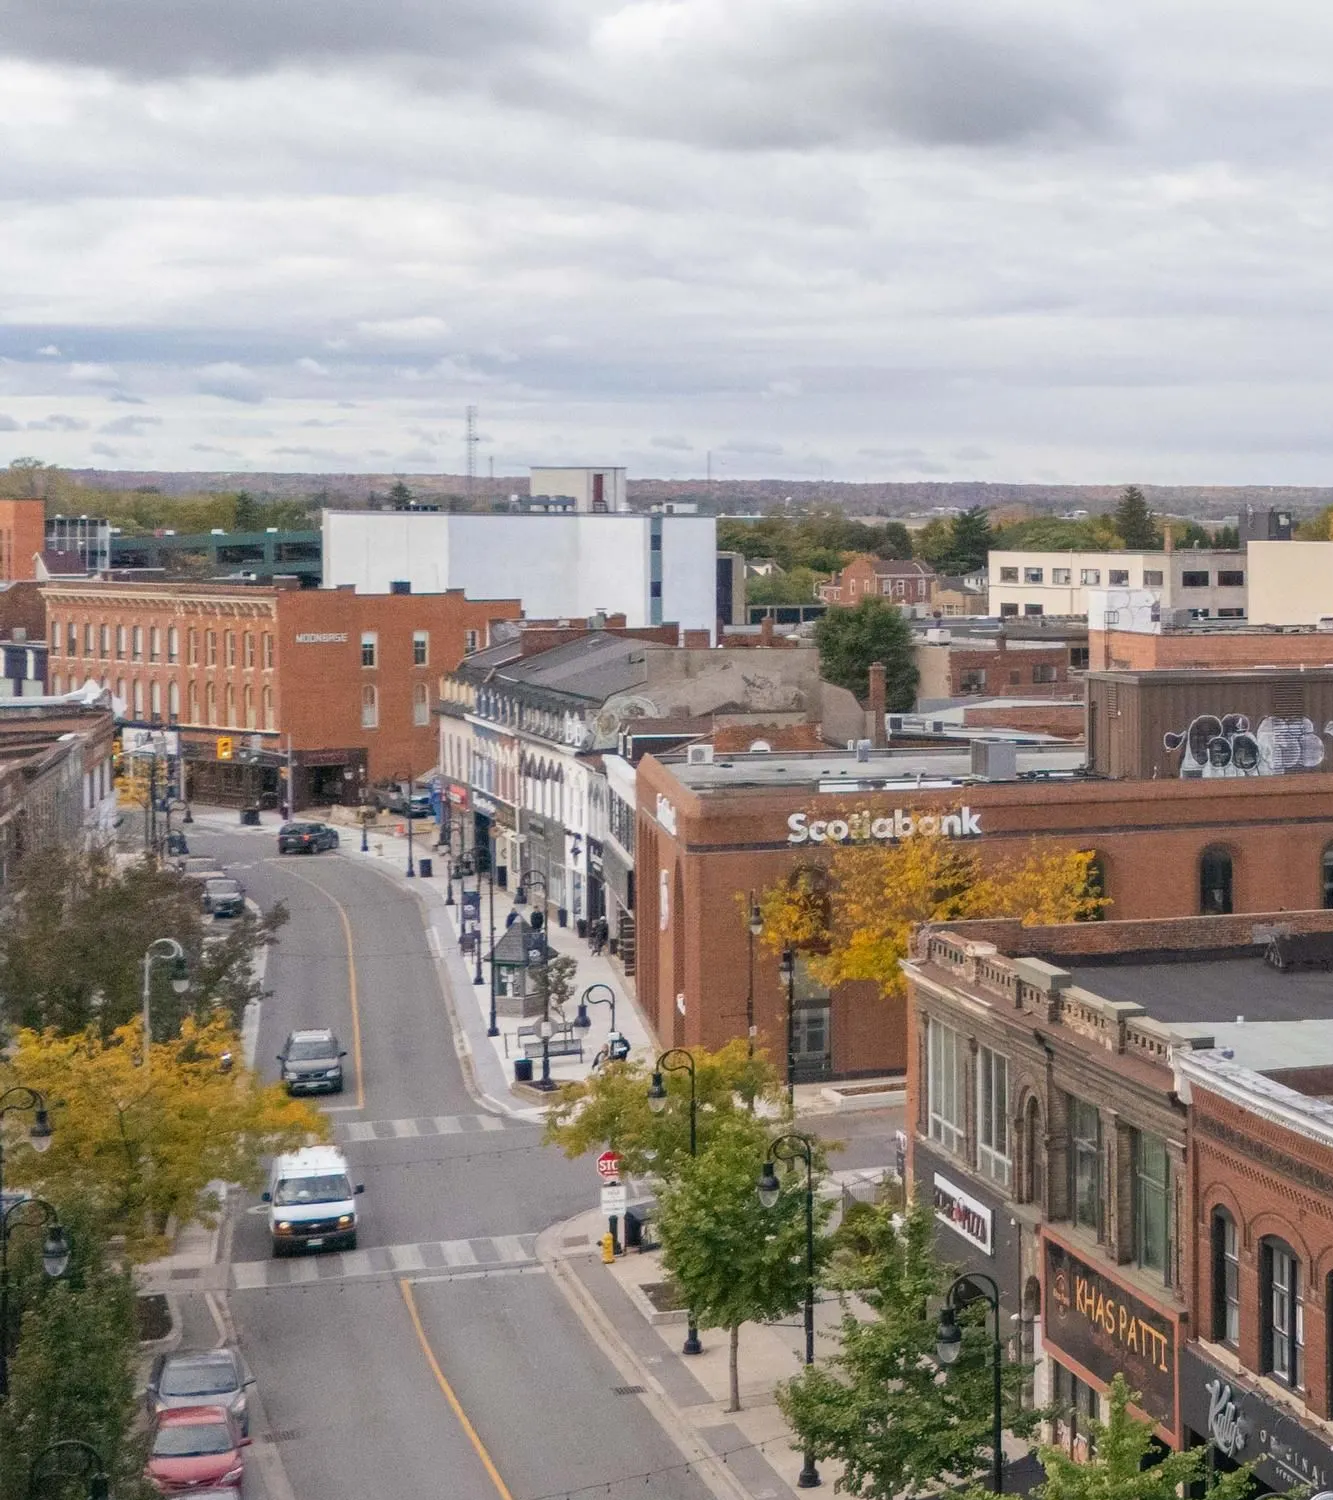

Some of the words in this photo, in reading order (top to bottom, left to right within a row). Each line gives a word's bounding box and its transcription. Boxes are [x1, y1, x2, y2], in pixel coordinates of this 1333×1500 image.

[787, 806, 982, 843] Scotiabank
[600, 1160, 619, 1172] STO
[1076, 1275, 1116, 1335] KHAS
[1119, 1305, 1168, 1373] PATTI
